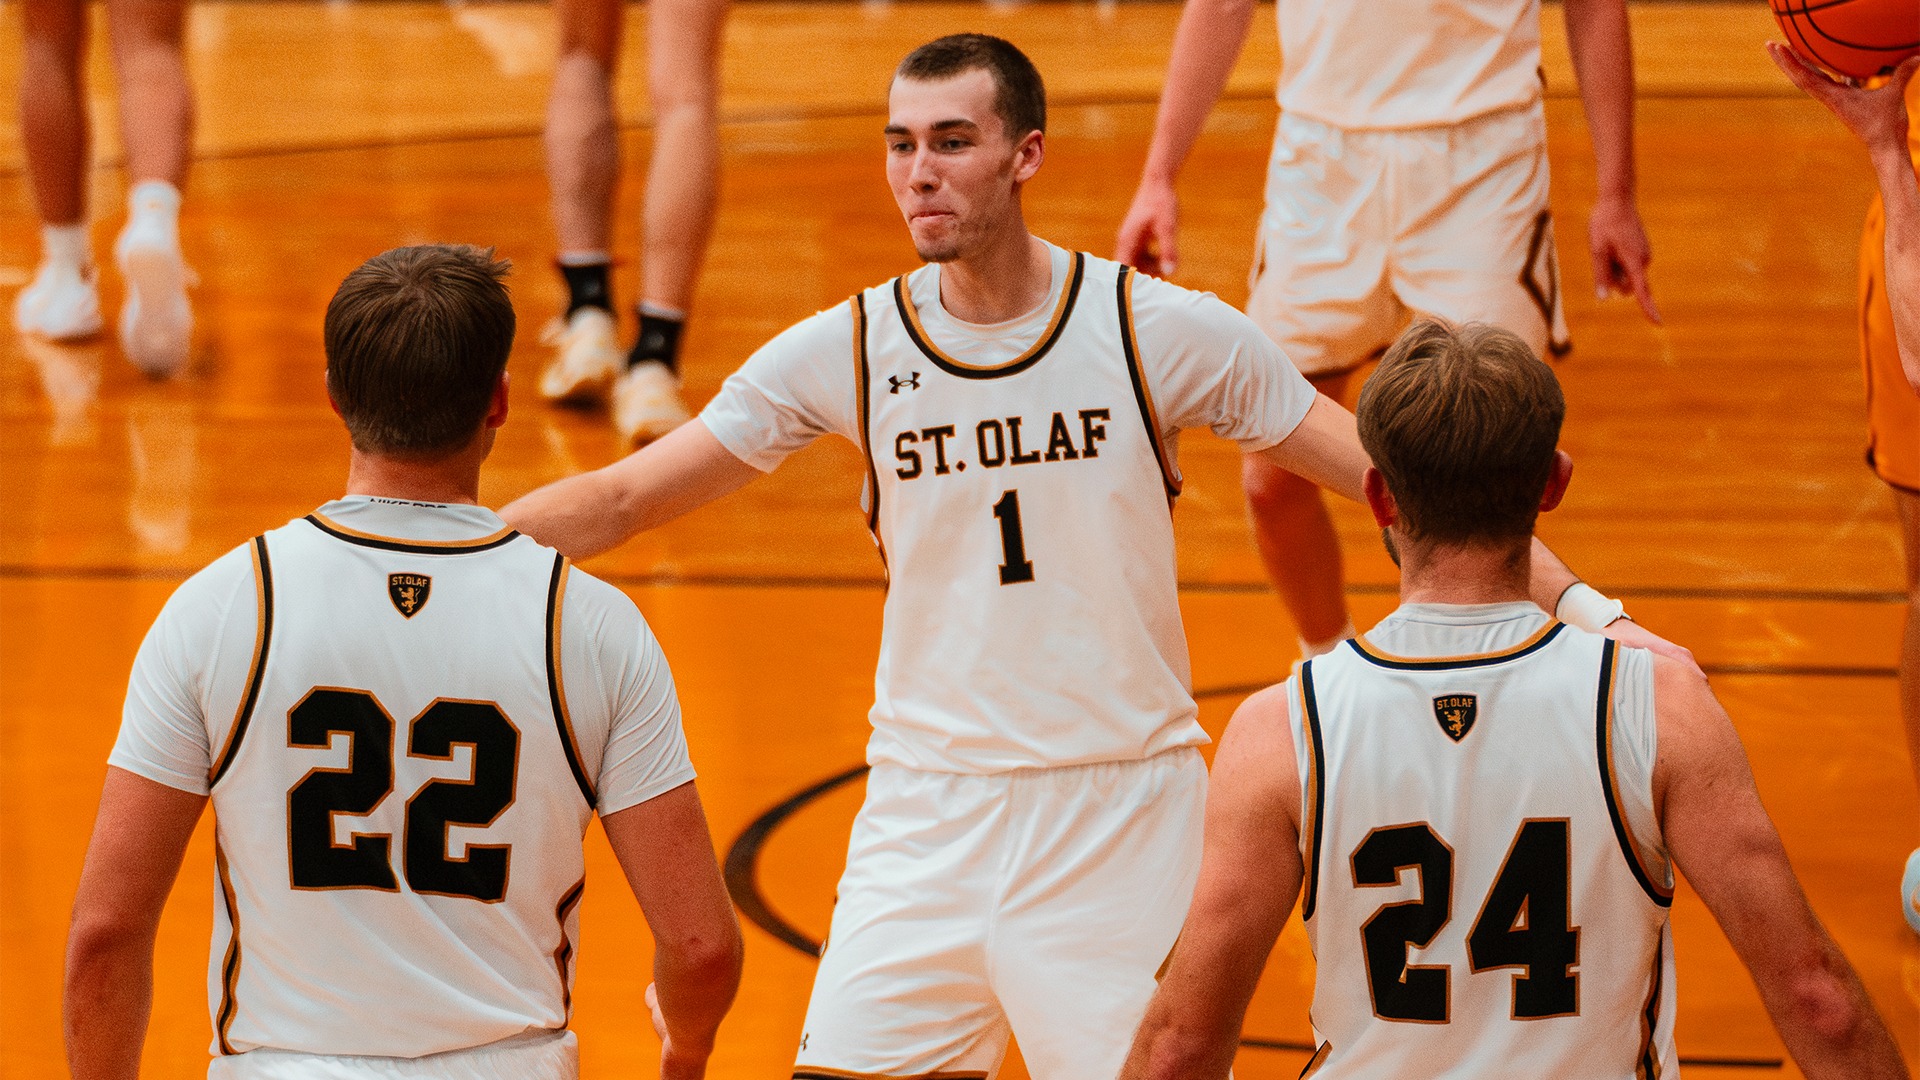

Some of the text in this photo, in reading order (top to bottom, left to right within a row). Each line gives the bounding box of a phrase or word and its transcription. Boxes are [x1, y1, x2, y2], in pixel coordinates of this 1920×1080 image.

[895, 408, 1111, 481] ST. OLAF
[992, 488, 1035, 586] 1
[405, 576, 428, 587] OLAF
[1450, 697, 1473, 708] OLAF
[286, 685, 522, 904] 22
[1348, 817, 1581, 1025] 24
